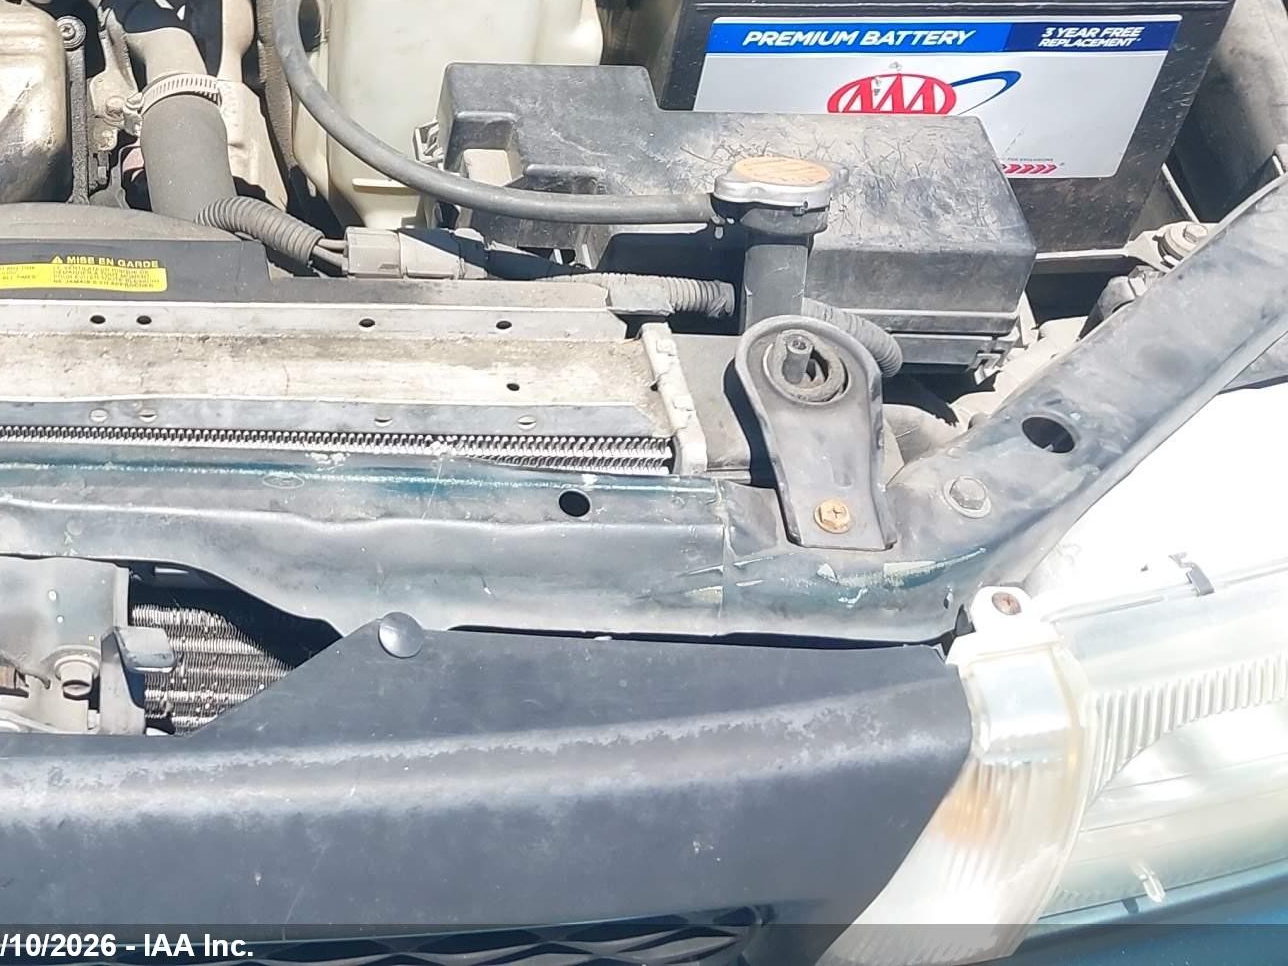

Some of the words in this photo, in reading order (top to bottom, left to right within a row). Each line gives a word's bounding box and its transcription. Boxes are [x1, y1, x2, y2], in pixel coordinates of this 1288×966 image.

[742, 29, 859, 46] PREMIUM
[860, 29, 977, 46] BATTERY
[1042, 27, 1055, 38] 3
[1057, 27, 1099, 38] YEAR
[1100, 26, 1145, 38] FREE
[834, 73, 946, 114] AAA
[67, 256, 95, 264] MISE
[99, 257, 114, 266] EN
[117, 259, 159, 268] GARDE
